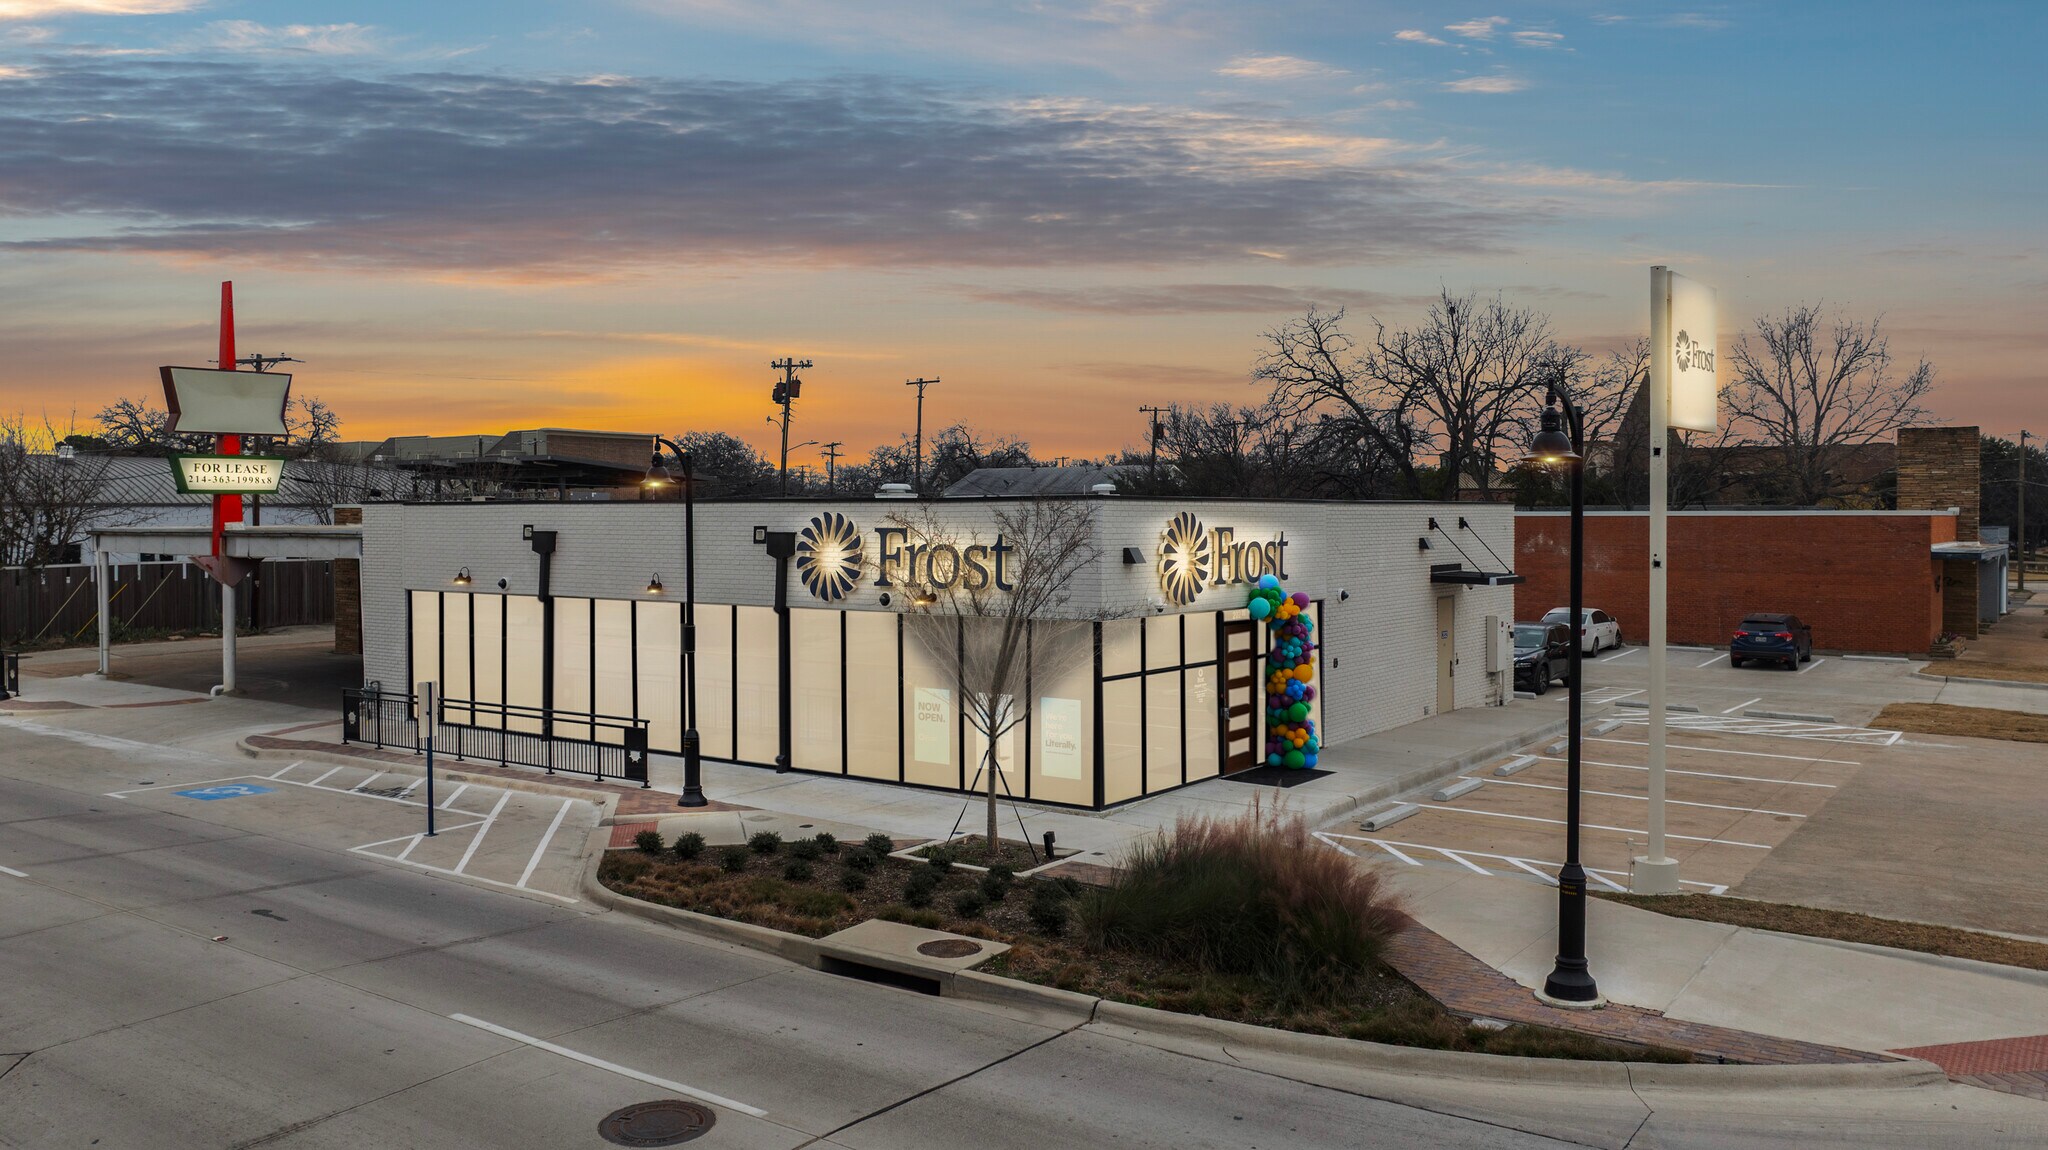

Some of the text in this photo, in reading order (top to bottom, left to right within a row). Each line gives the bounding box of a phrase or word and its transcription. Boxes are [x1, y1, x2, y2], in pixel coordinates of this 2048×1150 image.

[1691, 340, 1715, 373] Frost
[194, 463, 268, 474] FOR LEASE
[188, 475, 272, 484] 214-363-1998x8
[874, 527, 1014, 592] Frost
[1210, 526, 1289, 585] Frost
[918, 701, 941, 712] NOW
[918, 712, 946, 723] OPEN.
[1045, 739, 1077, 751] Literally.
